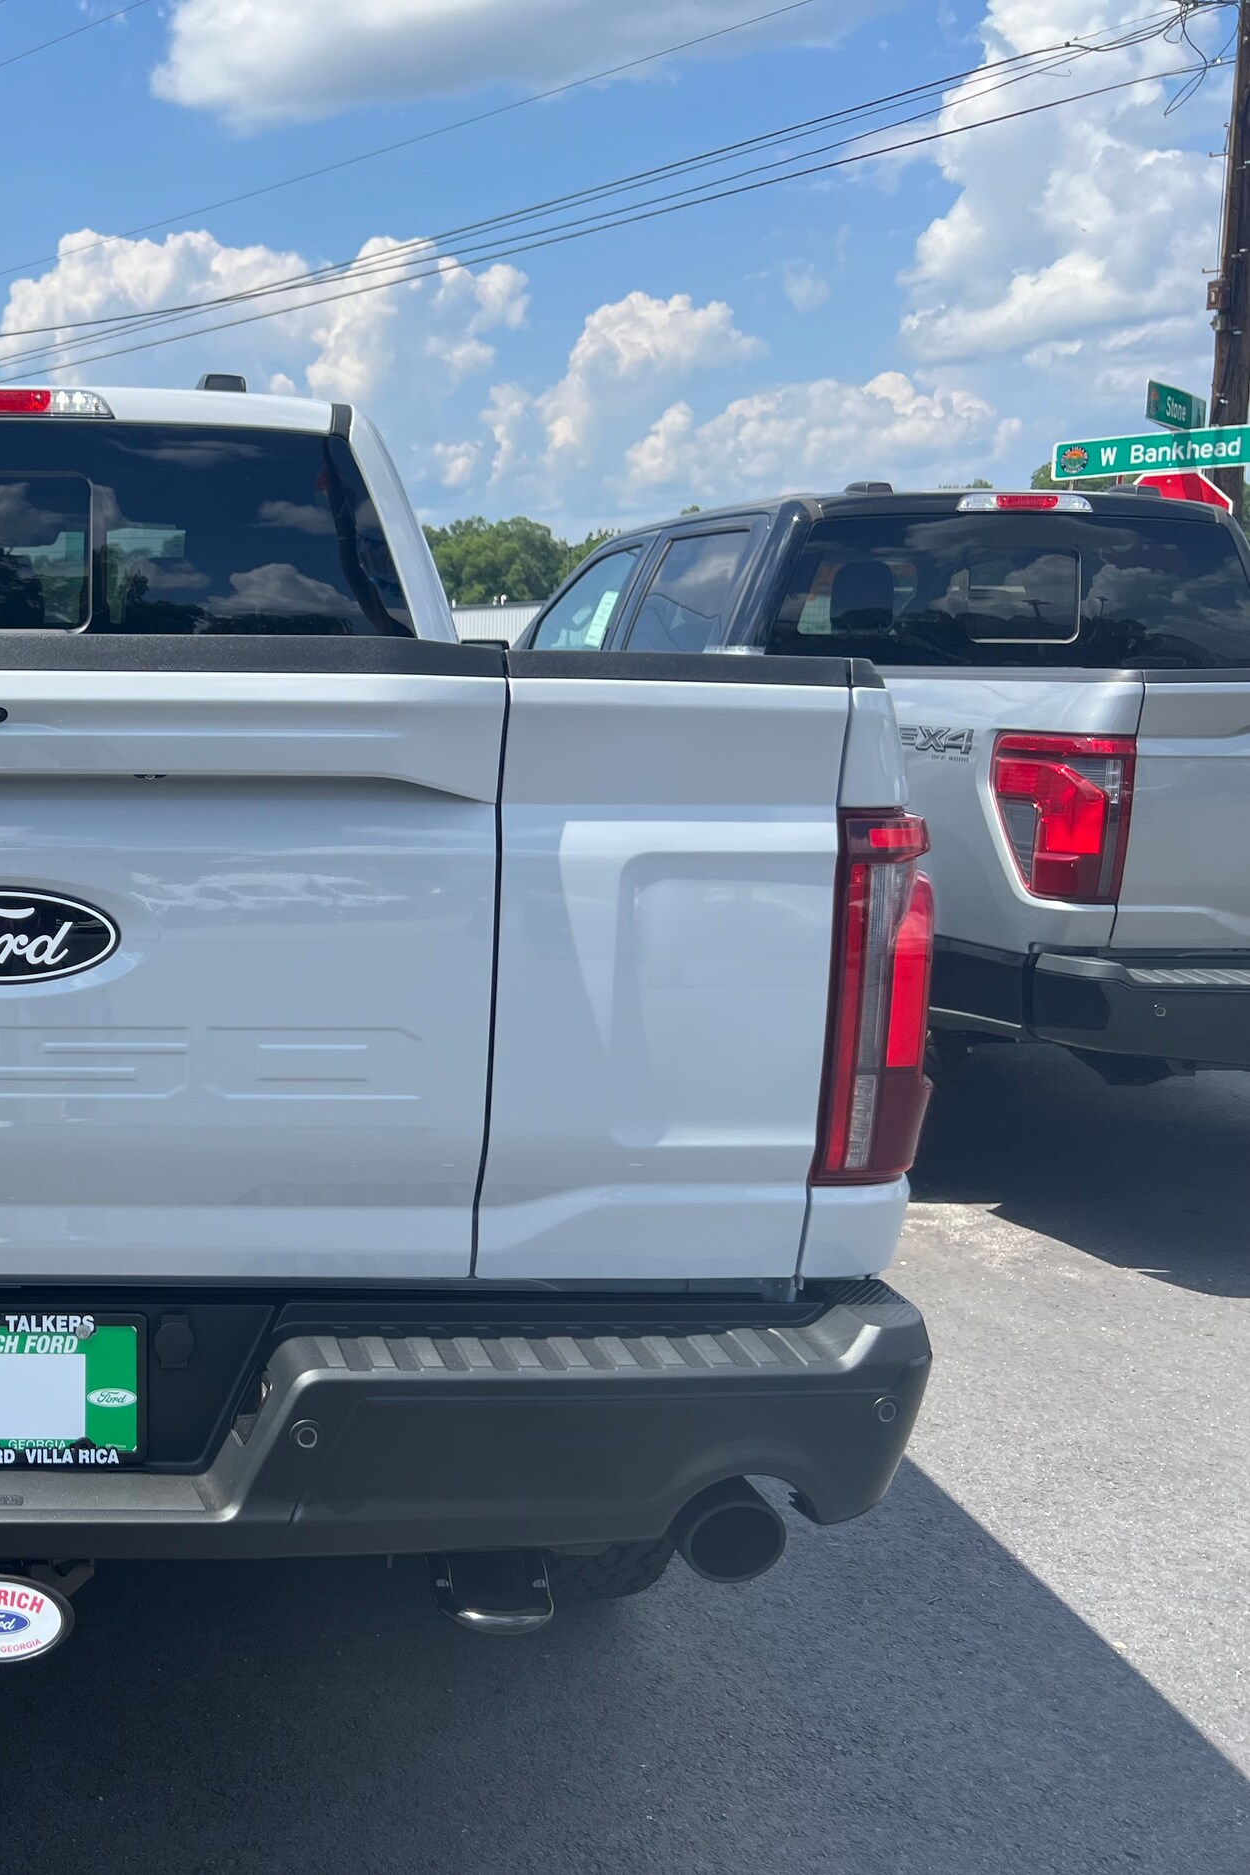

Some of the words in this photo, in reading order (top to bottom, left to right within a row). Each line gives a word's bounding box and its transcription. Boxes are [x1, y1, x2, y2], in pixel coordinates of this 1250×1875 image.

[1165, 396, 1187, 422] Stone
[1100, 447, 1118, 467] W
[1130, 437, 1242, 465] Bankhead
[6, 1315, 95, 1333] TALKERS
[24, 1335, 78, 1354] FORD
[97, 1391, 126, 1404] Ford
[25, 1449, 73, 1465] VILLA
[78, 1449, 120, 1465] RICA
[0, 1638, 42, 1653] GEORGIA
